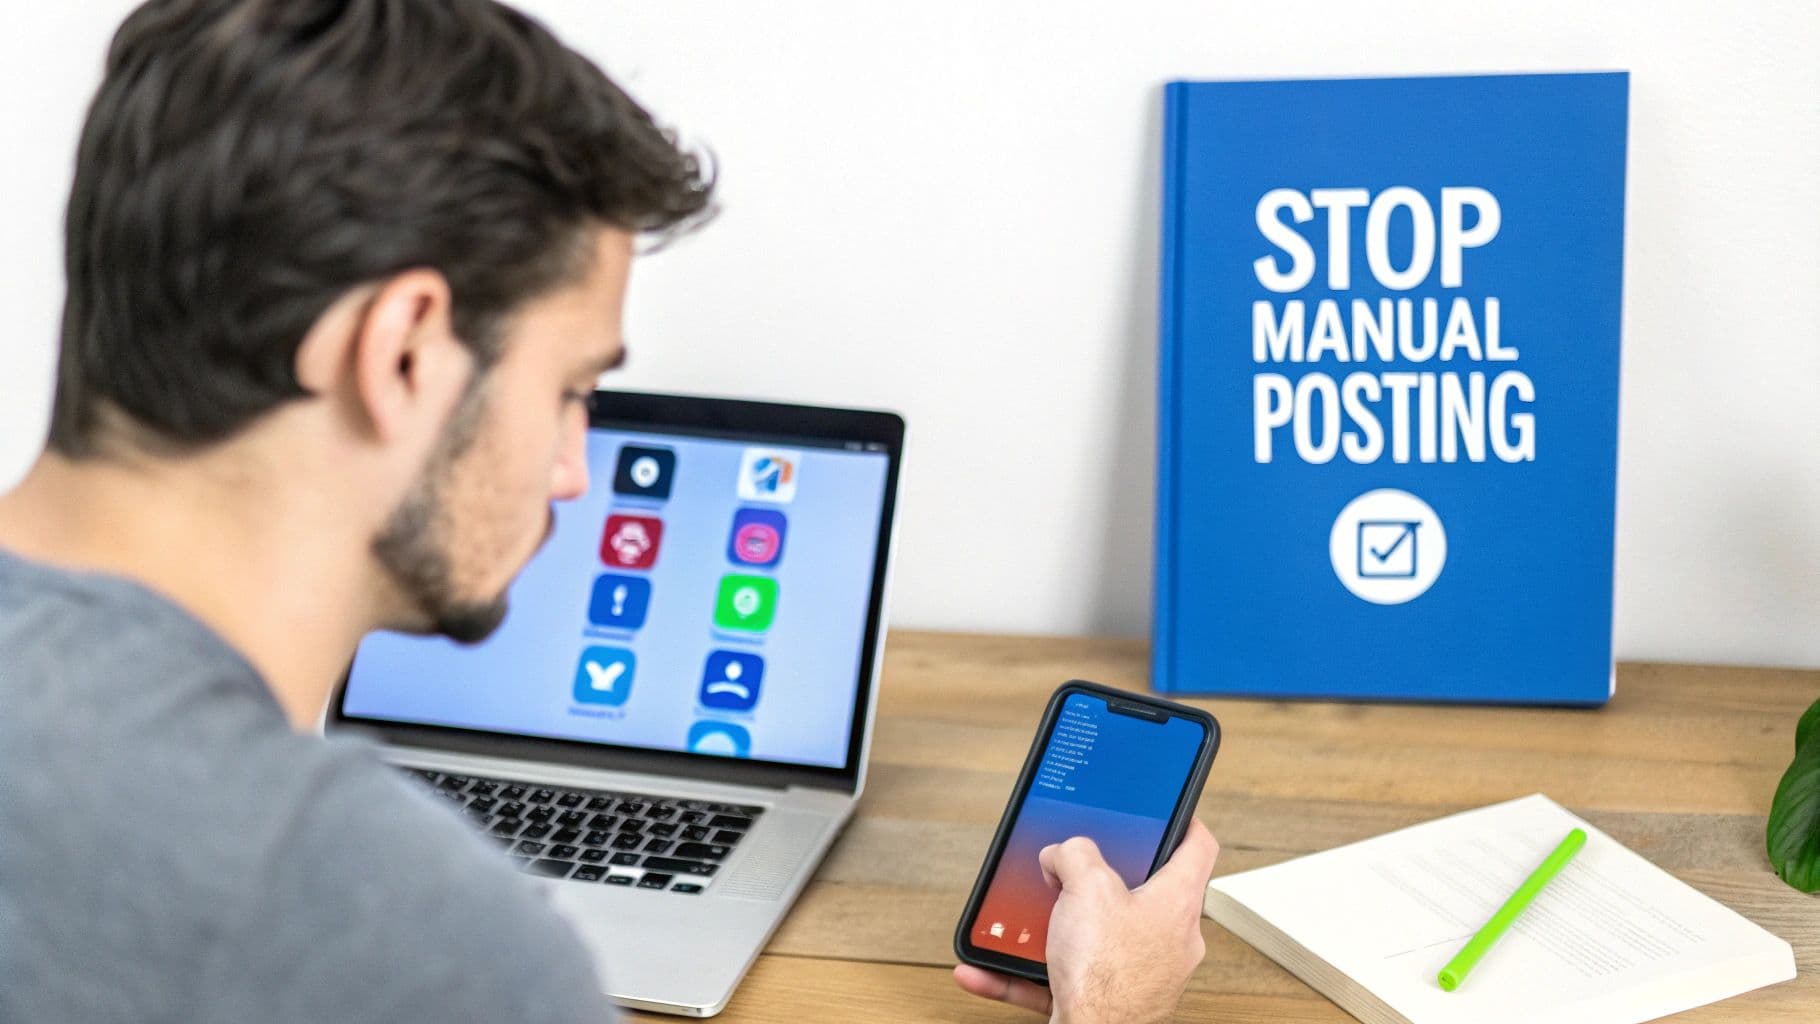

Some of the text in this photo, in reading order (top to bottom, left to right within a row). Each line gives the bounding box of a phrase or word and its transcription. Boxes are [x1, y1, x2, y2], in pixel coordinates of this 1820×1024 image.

[1253, 186, 1501, 292] STOP
[1252, 297, 1518, 363] MANUAL
[1253, 370, 1536, 465] POSTING
